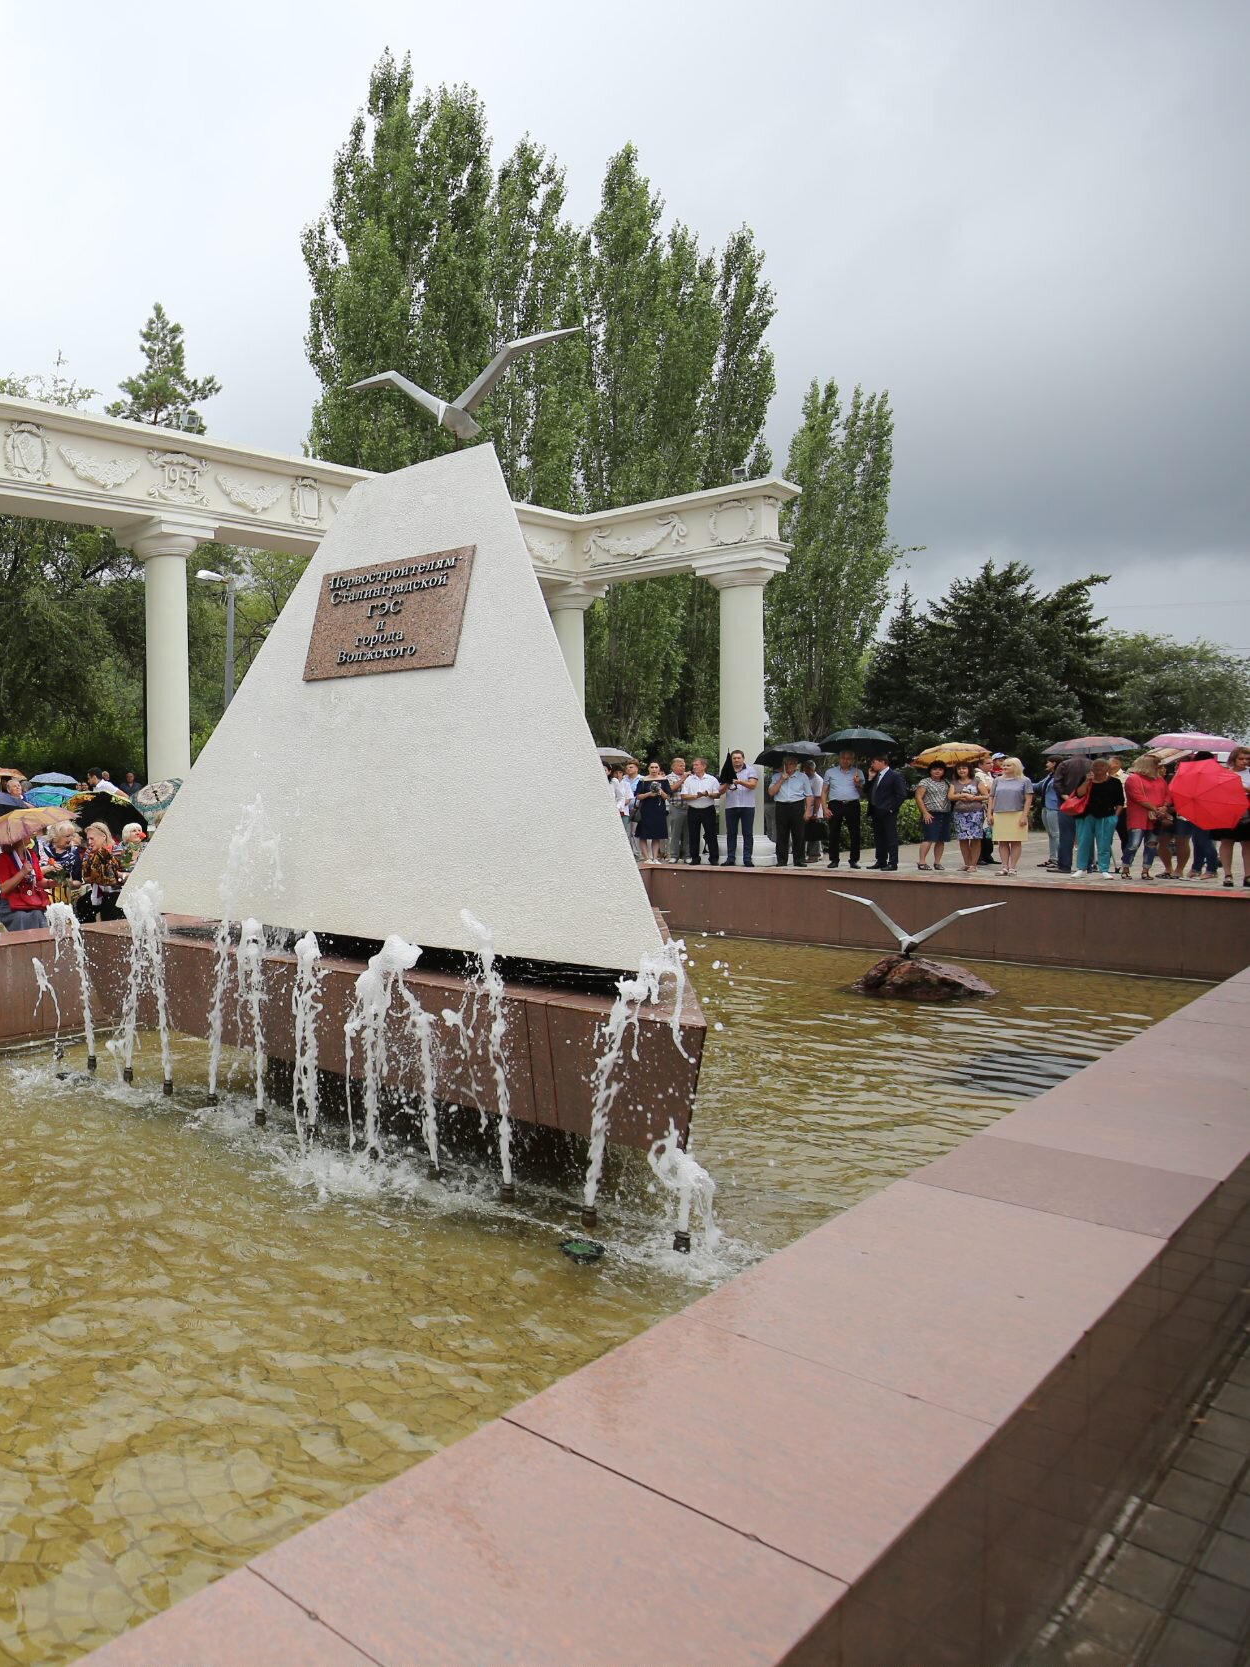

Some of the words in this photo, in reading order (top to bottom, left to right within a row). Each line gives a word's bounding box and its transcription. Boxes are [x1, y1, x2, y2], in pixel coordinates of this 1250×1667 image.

[161, 466, 200, 492] 1954
[329, 557, 457, 591] Первостроителям
[330, 571, 448, 605] Сталинградской
[367, 599, 403, 617] ГЭС
[376, 620, 385, 631] и
[355, 630, 404, 648] города
[337, 644, 416, 664] Волжского
